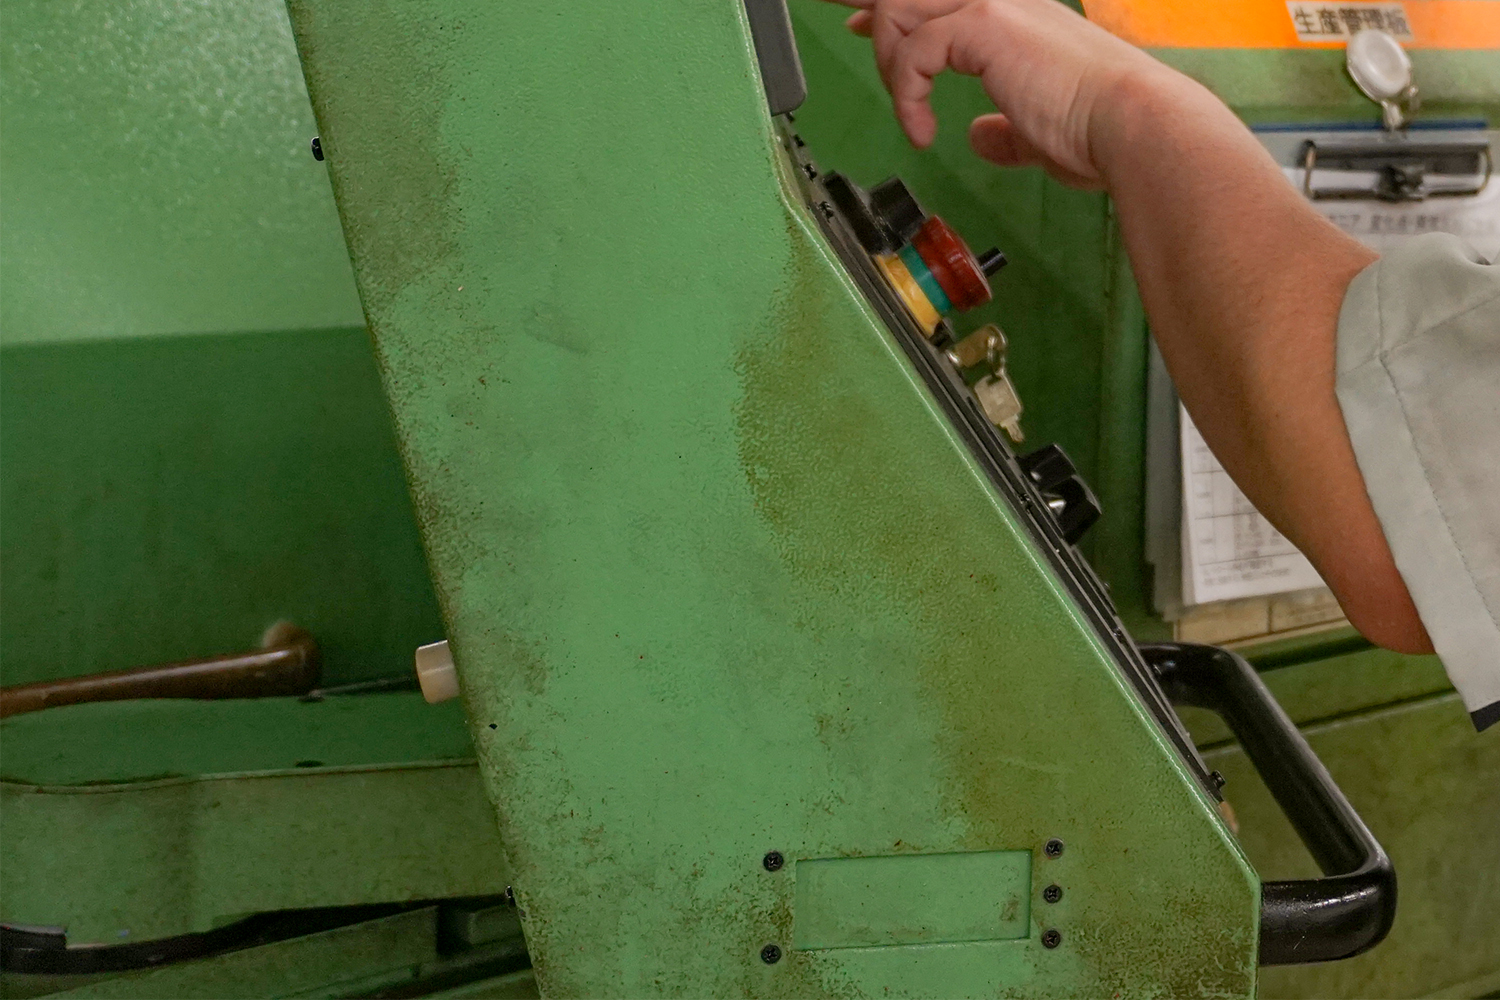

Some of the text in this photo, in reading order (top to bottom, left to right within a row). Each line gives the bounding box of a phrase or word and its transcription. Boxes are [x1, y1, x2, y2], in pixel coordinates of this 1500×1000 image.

[1293, 5, 1411, 36] 生産管理板
